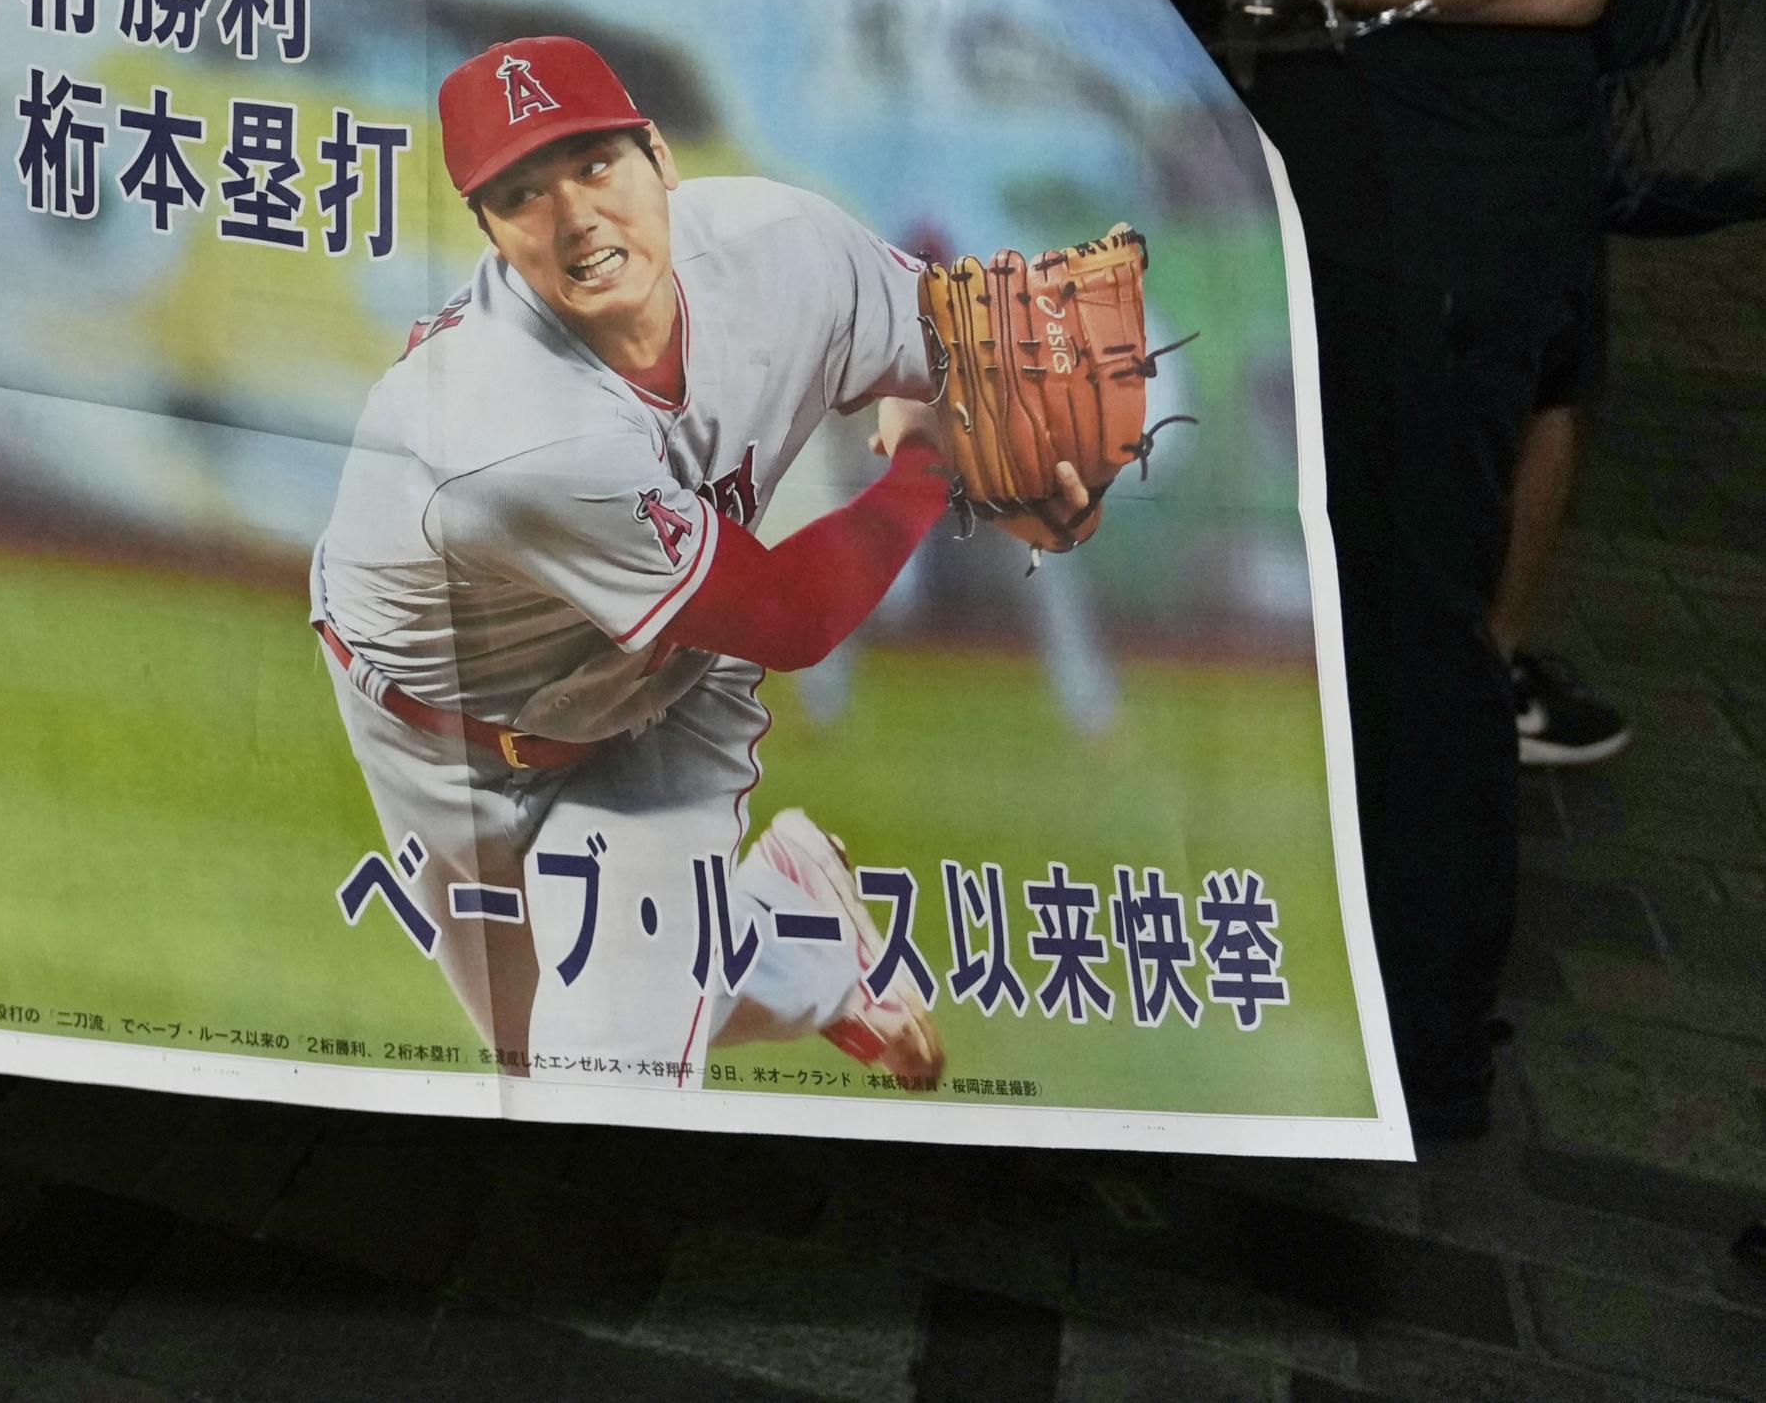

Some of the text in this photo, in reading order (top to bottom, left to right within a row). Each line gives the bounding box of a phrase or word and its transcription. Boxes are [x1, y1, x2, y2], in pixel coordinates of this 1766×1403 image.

[1046, 321, 1072, 375] asics
[334, 829, 1290, 1031] ベーブ・ルース以来快挙
